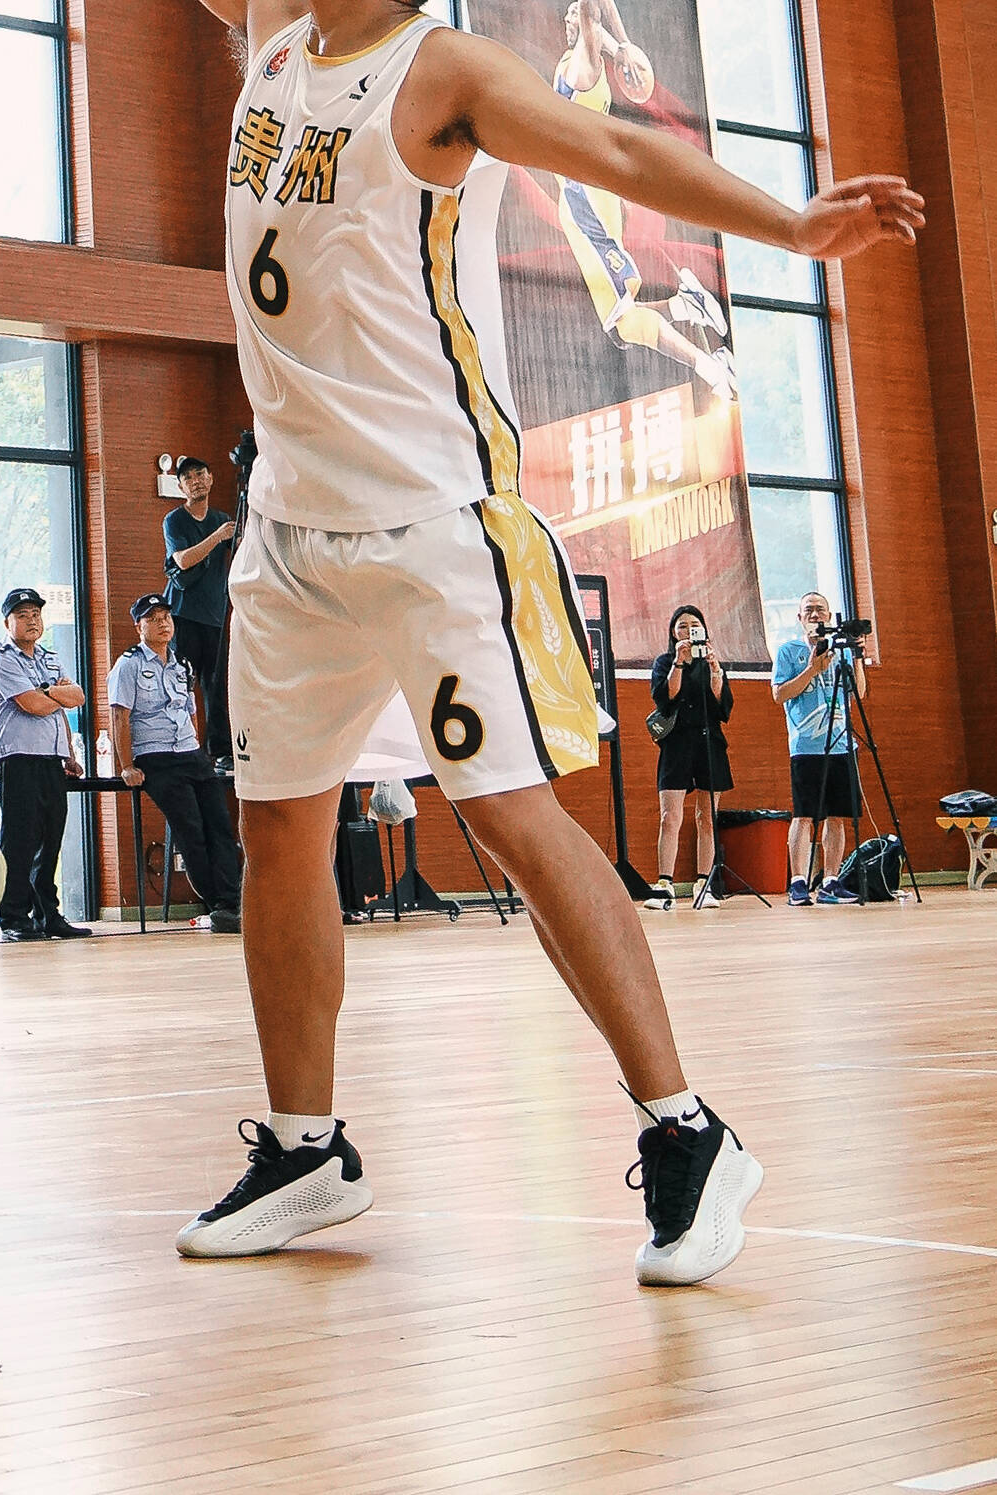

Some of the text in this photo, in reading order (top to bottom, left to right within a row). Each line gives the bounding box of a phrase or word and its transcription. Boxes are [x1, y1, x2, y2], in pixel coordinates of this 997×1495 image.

[230, 106, 352, 206] 贵州
[249, 227, 291, 318] 6
[568, 391, 684, 517] 拼搏
[629, 476, 735, 561] HARDWORK
[430, 673, 485, 765] 6
